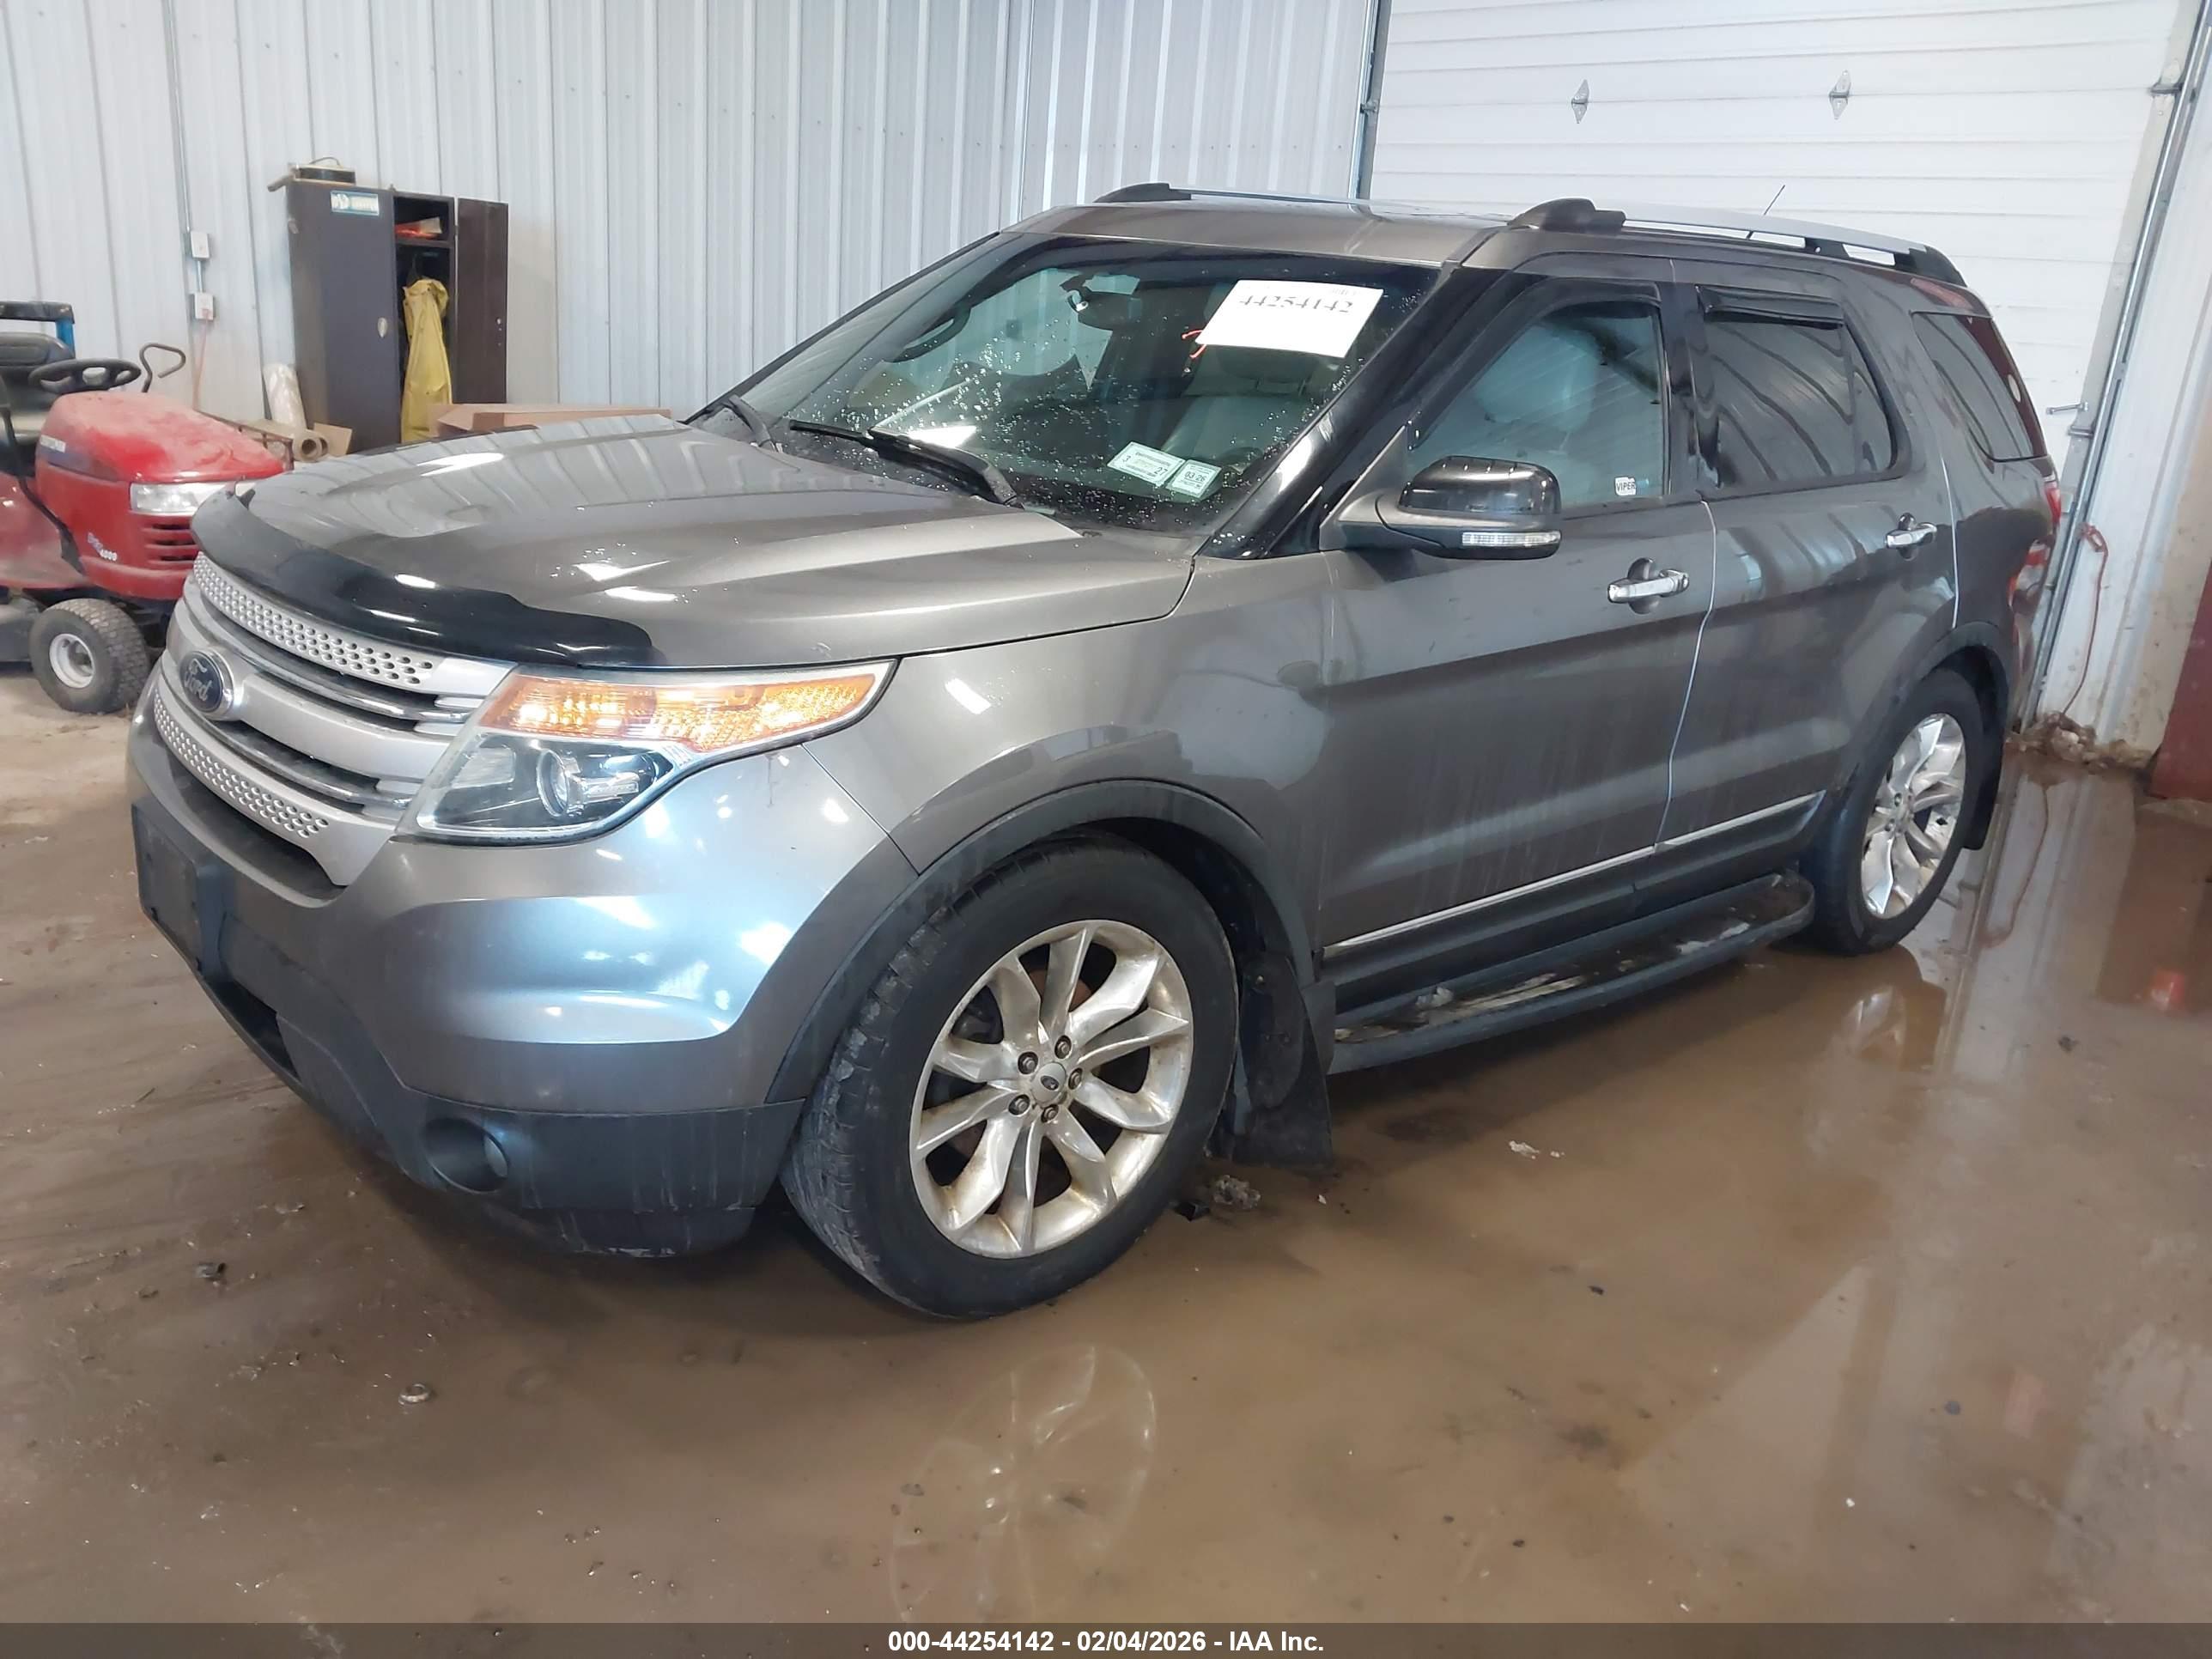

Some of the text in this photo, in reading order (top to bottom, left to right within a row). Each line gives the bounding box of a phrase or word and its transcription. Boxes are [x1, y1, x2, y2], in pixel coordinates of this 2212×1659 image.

[1239, 295, 1353, 313] 44254142
[1616, 481, 1636, 491] VIPER
[184, 658, 213, 702] Ford
